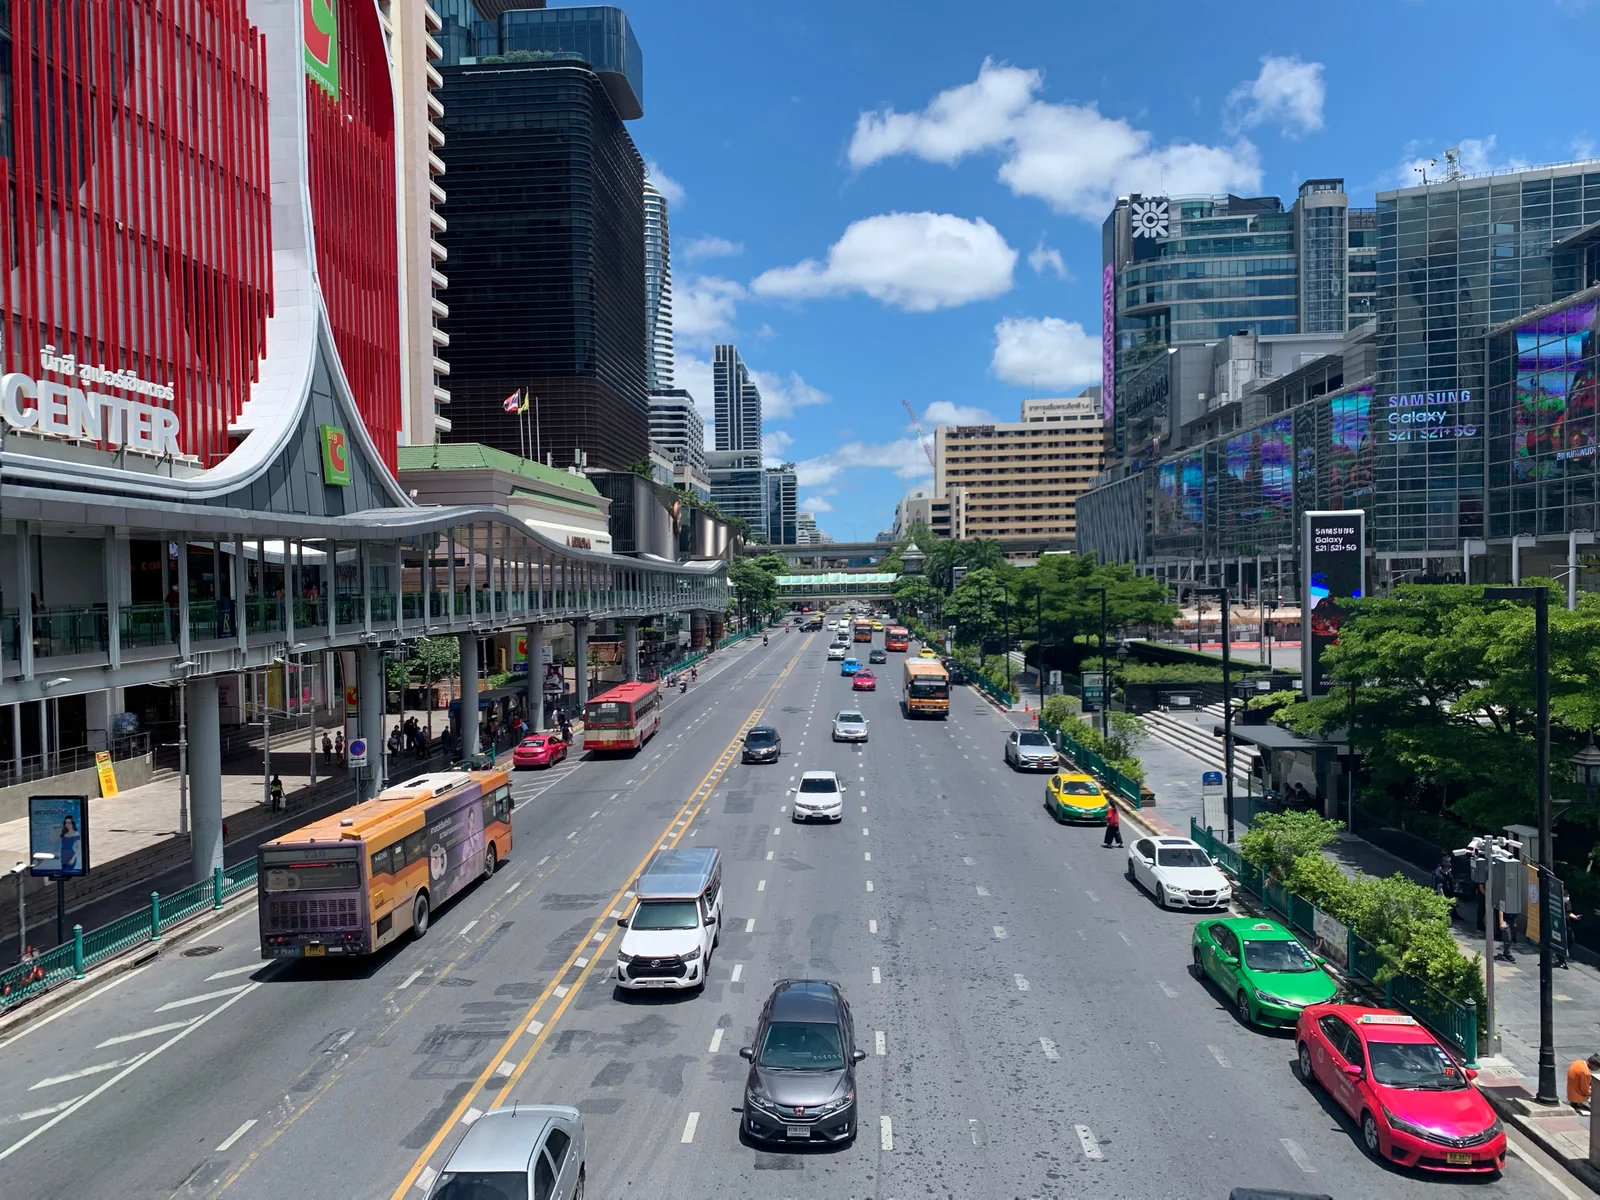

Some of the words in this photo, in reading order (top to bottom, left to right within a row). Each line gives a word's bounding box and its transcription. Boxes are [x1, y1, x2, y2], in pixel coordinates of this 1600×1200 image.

[1389, 390, 1471, 408] SAMSUNG
[0, 373, 183, 456] CENTER
[1388, 410, 1447, 425] Galaxy
[1315, 527, 1355, 535] SAMSUNG
[1315, 537, 1343, 545] Galaxy
